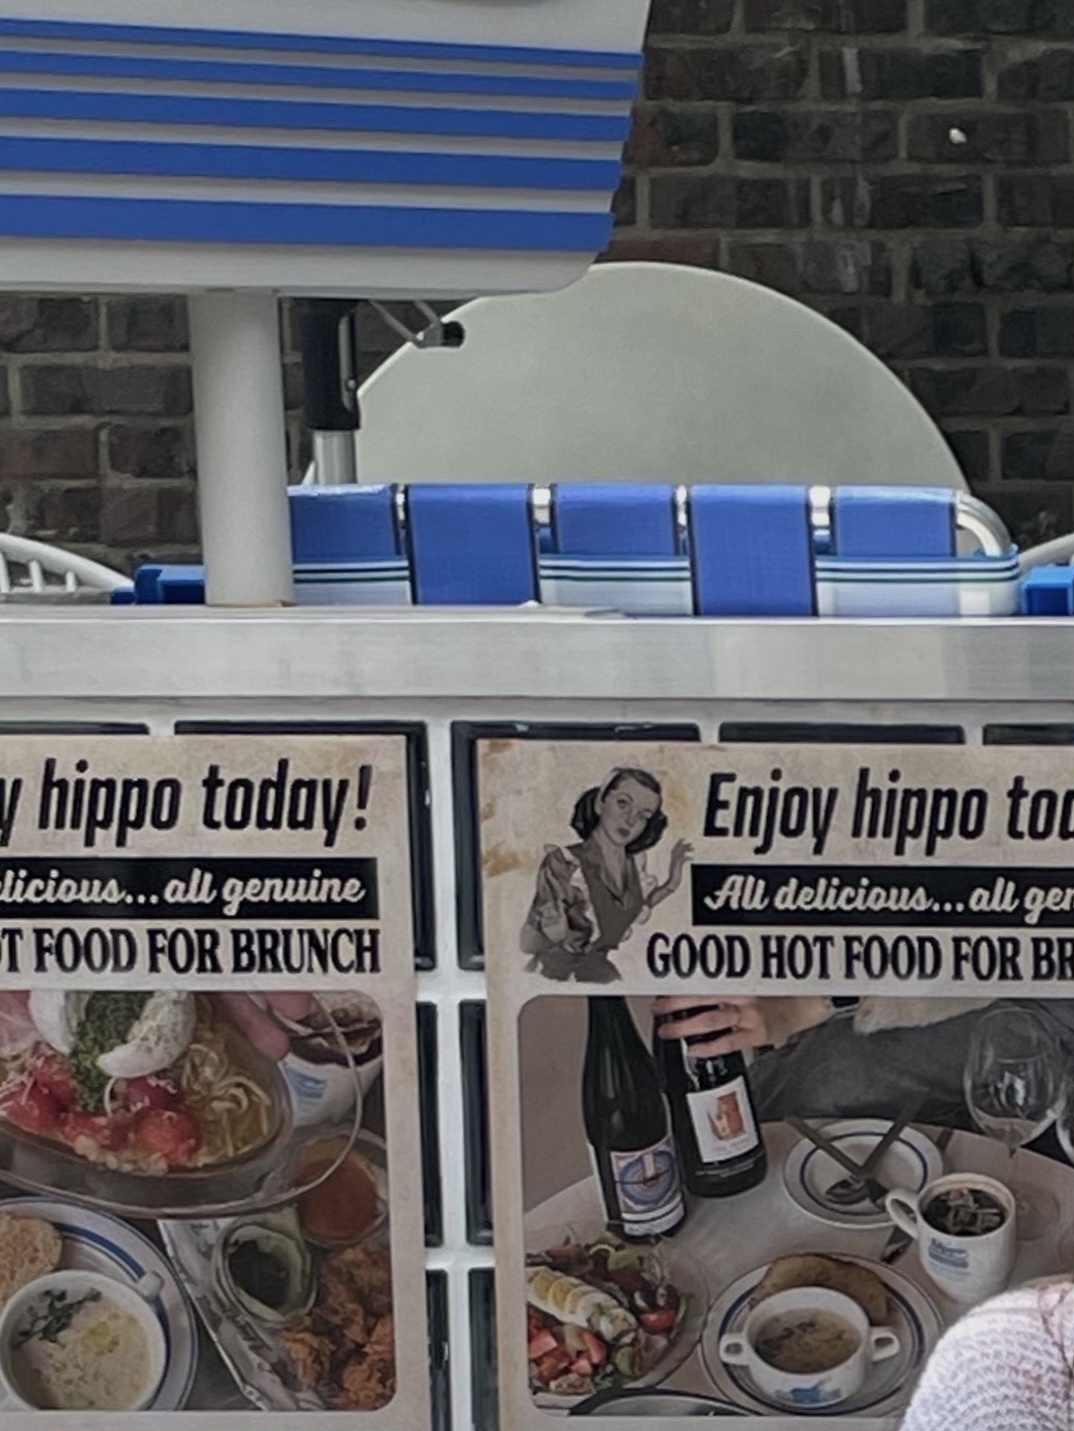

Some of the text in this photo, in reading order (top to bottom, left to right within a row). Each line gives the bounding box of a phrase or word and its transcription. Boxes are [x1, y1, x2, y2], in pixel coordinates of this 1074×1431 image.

[37, 757, 182, 848] hippo
[201, 758, 373, 848] today!
[703, 768, 839, 856] Enjoy
[851, 767, 988, 857] hippo
[221, 868, 366, 916] genuine
[703, 874, 770, 911] All
[32, 927, 138, 973] FOOD
[146, 927, 223, 975] FOR
[229, 927, 381, 974] BRUNCH
[646, 932, 751, 979] GOOD
[760, 934, 835, 980] HOT
[842, 934, 943, 980] FOOD
[951, 935, 1024, 982] FOR
